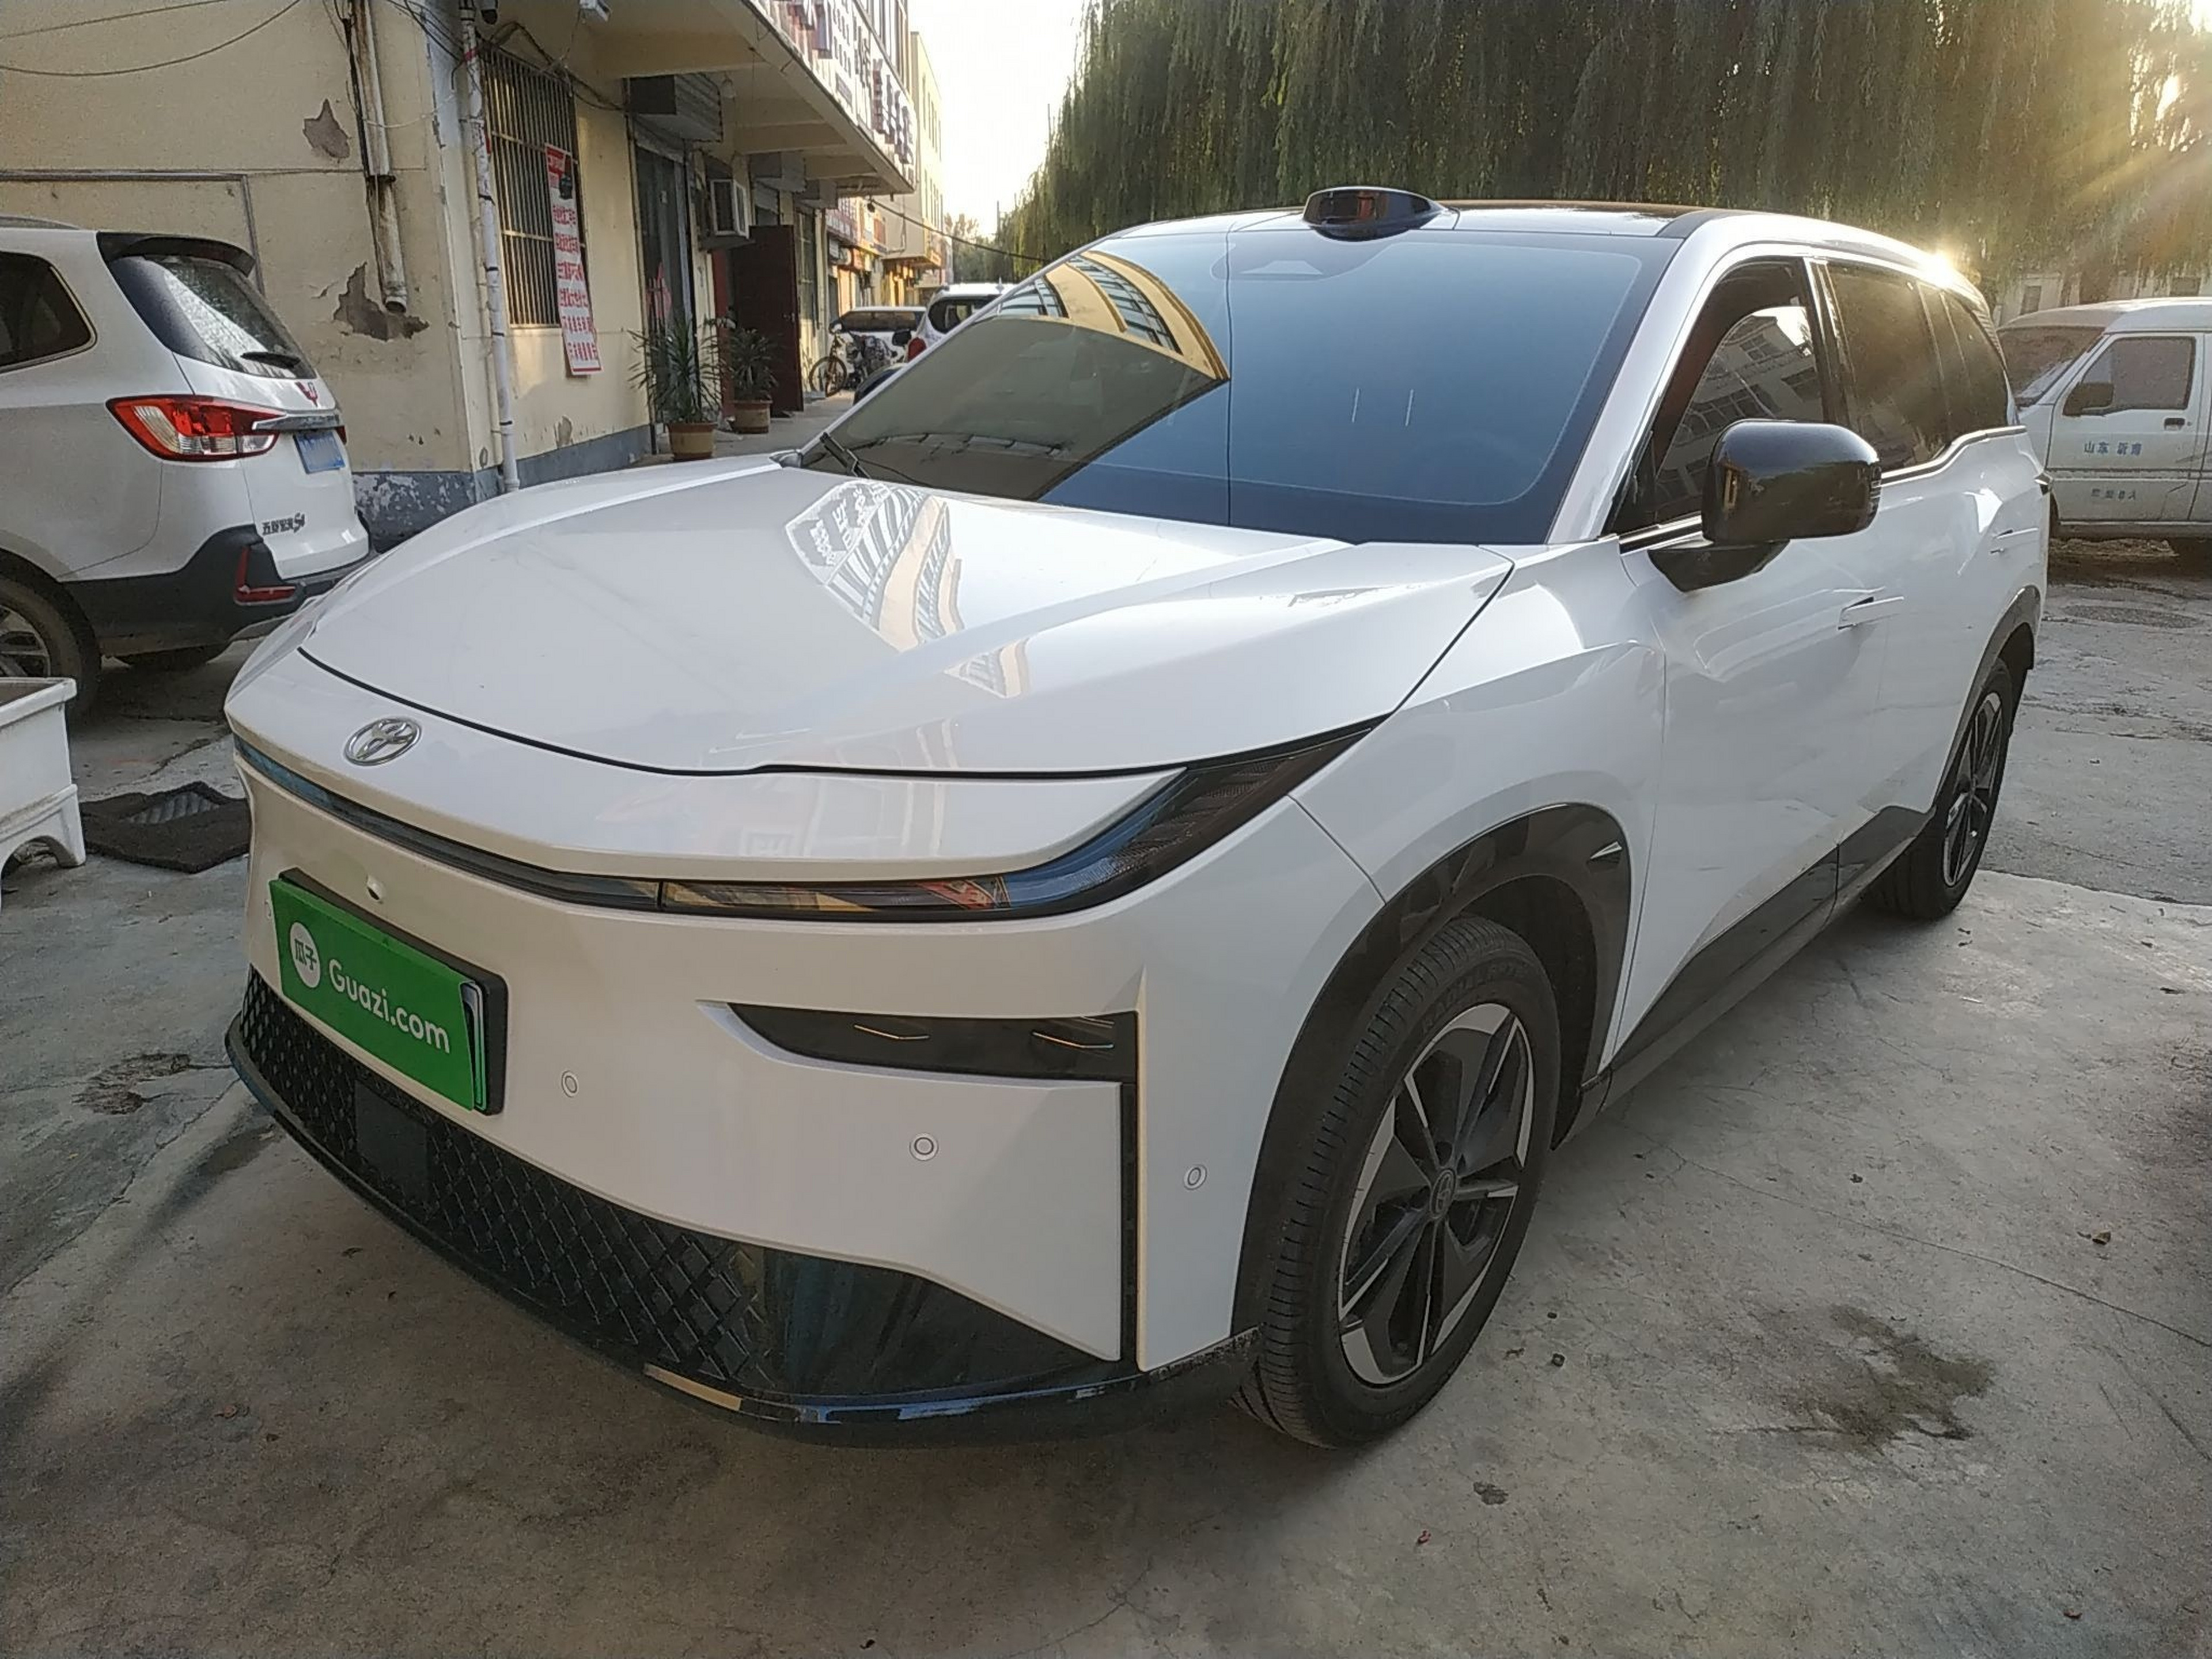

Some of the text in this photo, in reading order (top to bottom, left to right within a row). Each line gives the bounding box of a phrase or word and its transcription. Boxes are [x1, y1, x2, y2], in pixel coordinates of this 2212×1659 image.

[2084, 441, 2109, 454] 山东
[294, 938, 318, 972] 瓜子
[328, 959, 451, 1054] Guazi.com
